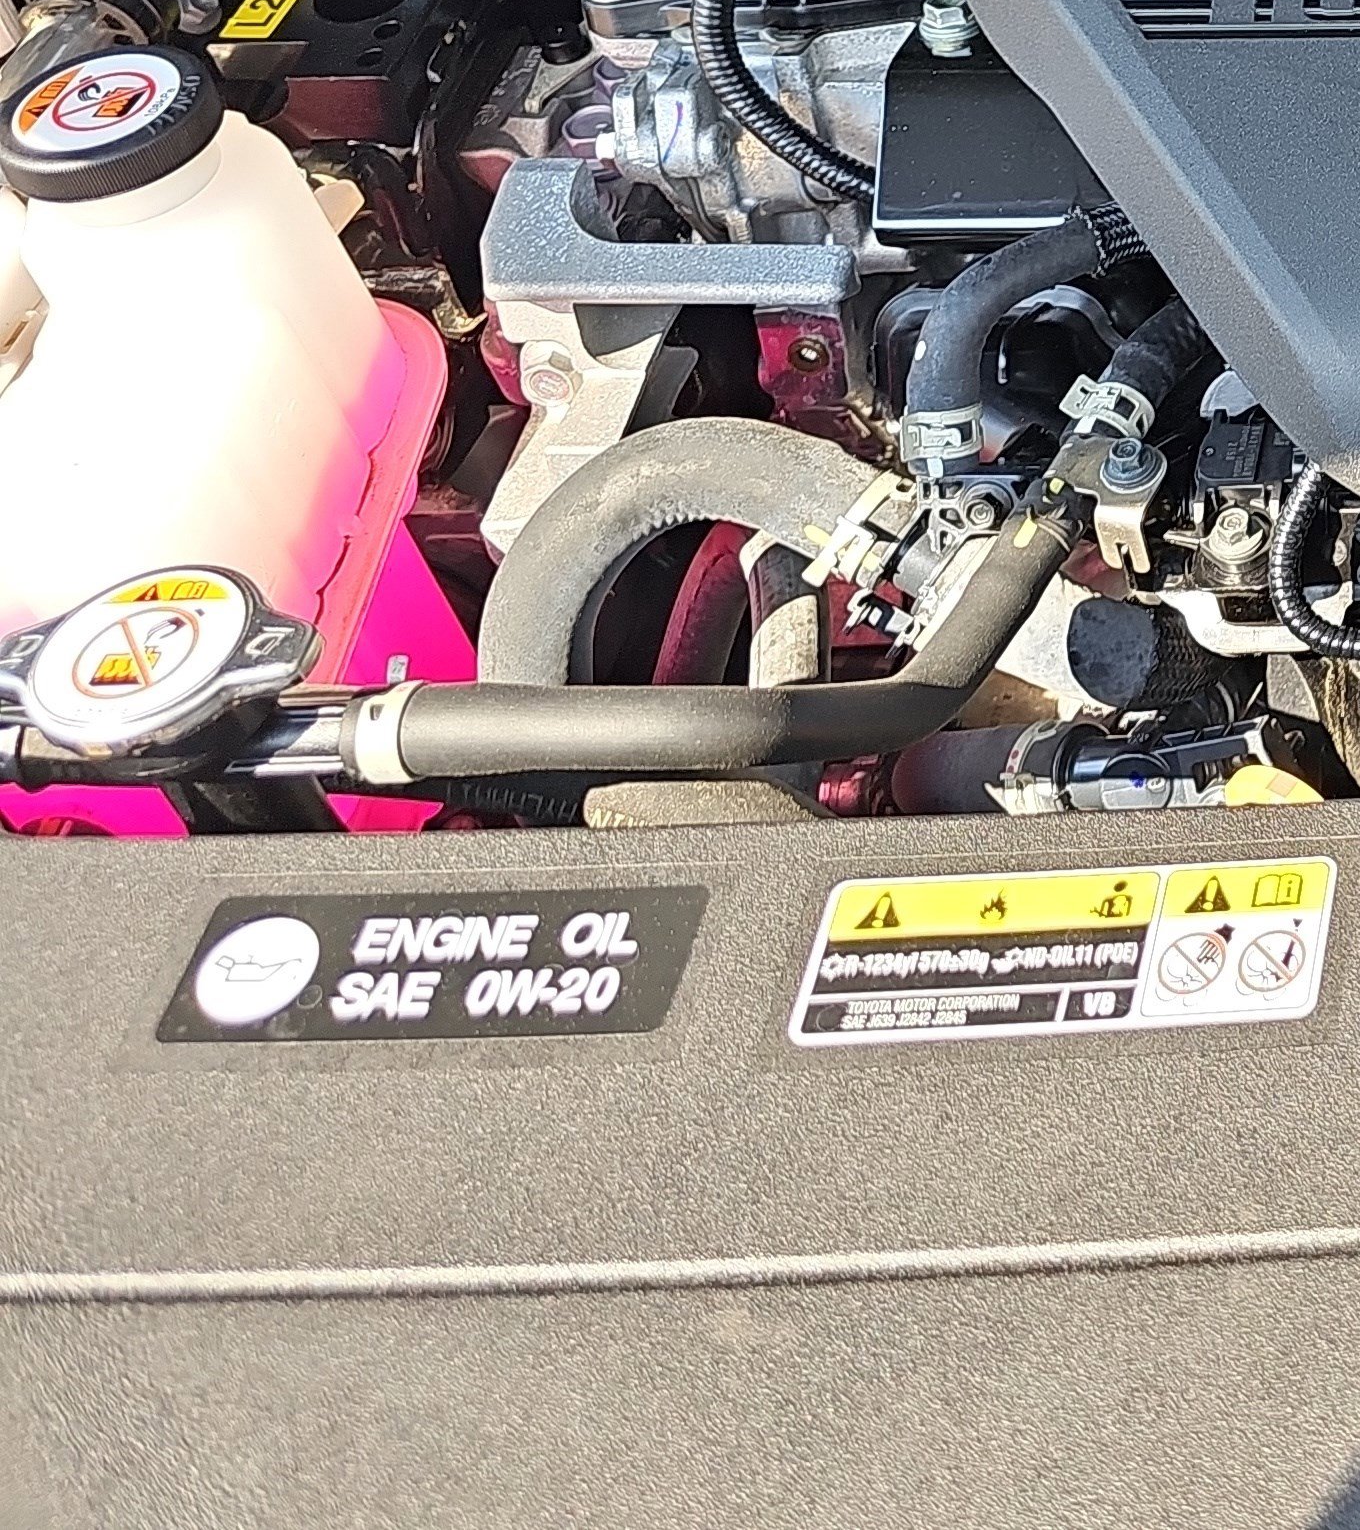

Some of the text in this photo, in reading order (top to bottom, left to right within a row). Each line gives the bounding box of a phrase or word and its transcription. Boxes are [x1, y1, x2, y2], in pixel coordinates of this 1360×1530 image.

[353, 911, 638, 965] ENGINE OIL
[329, 967, 621, 1021] SAE 0W-20
[847, 993, 1019, 1015] TOYOTA MOTOR CORPORATION
[841, 1014, 867, 1029] SAE
[867, 1013, 896, 1028] J639
[896, 1012, 930, 1027] J2842
